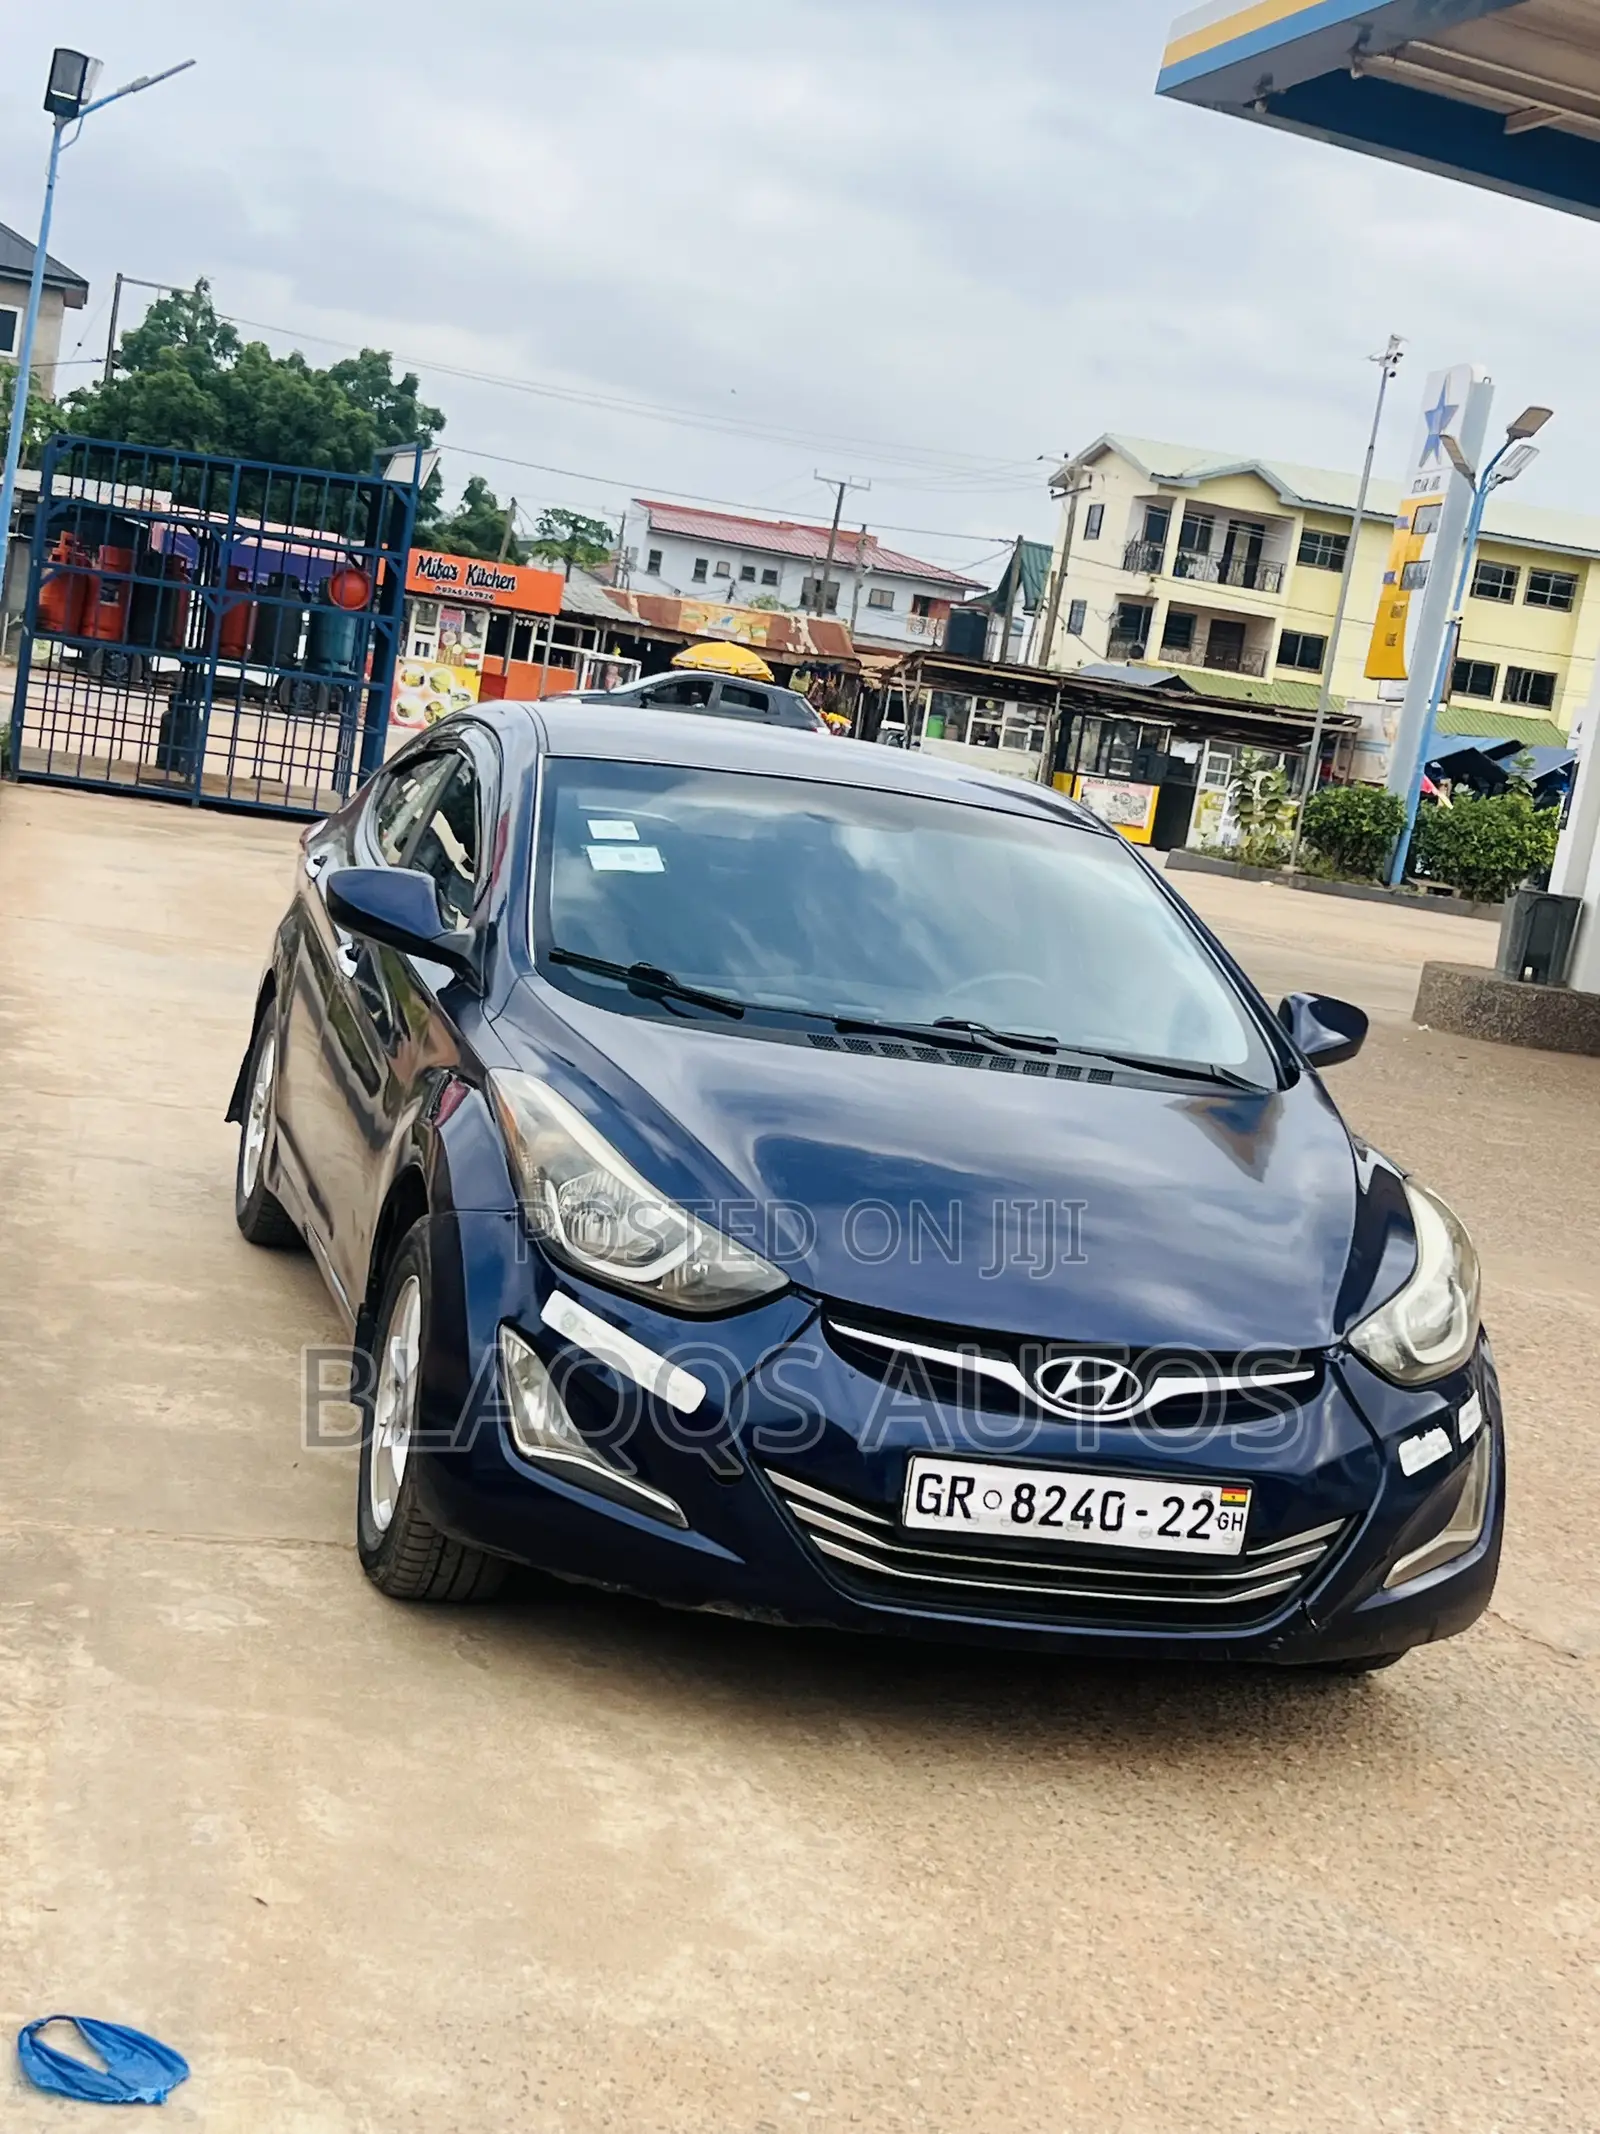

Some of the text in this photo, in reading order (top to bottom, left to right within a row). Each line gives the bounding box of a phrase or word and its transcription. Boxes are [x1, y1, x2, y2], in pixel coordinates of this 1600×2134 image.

[465, 563, 516, 591] Kitchen
[915, 1473, 976, 1519] GR
[1217, 1511, 1244, 1532] GH
